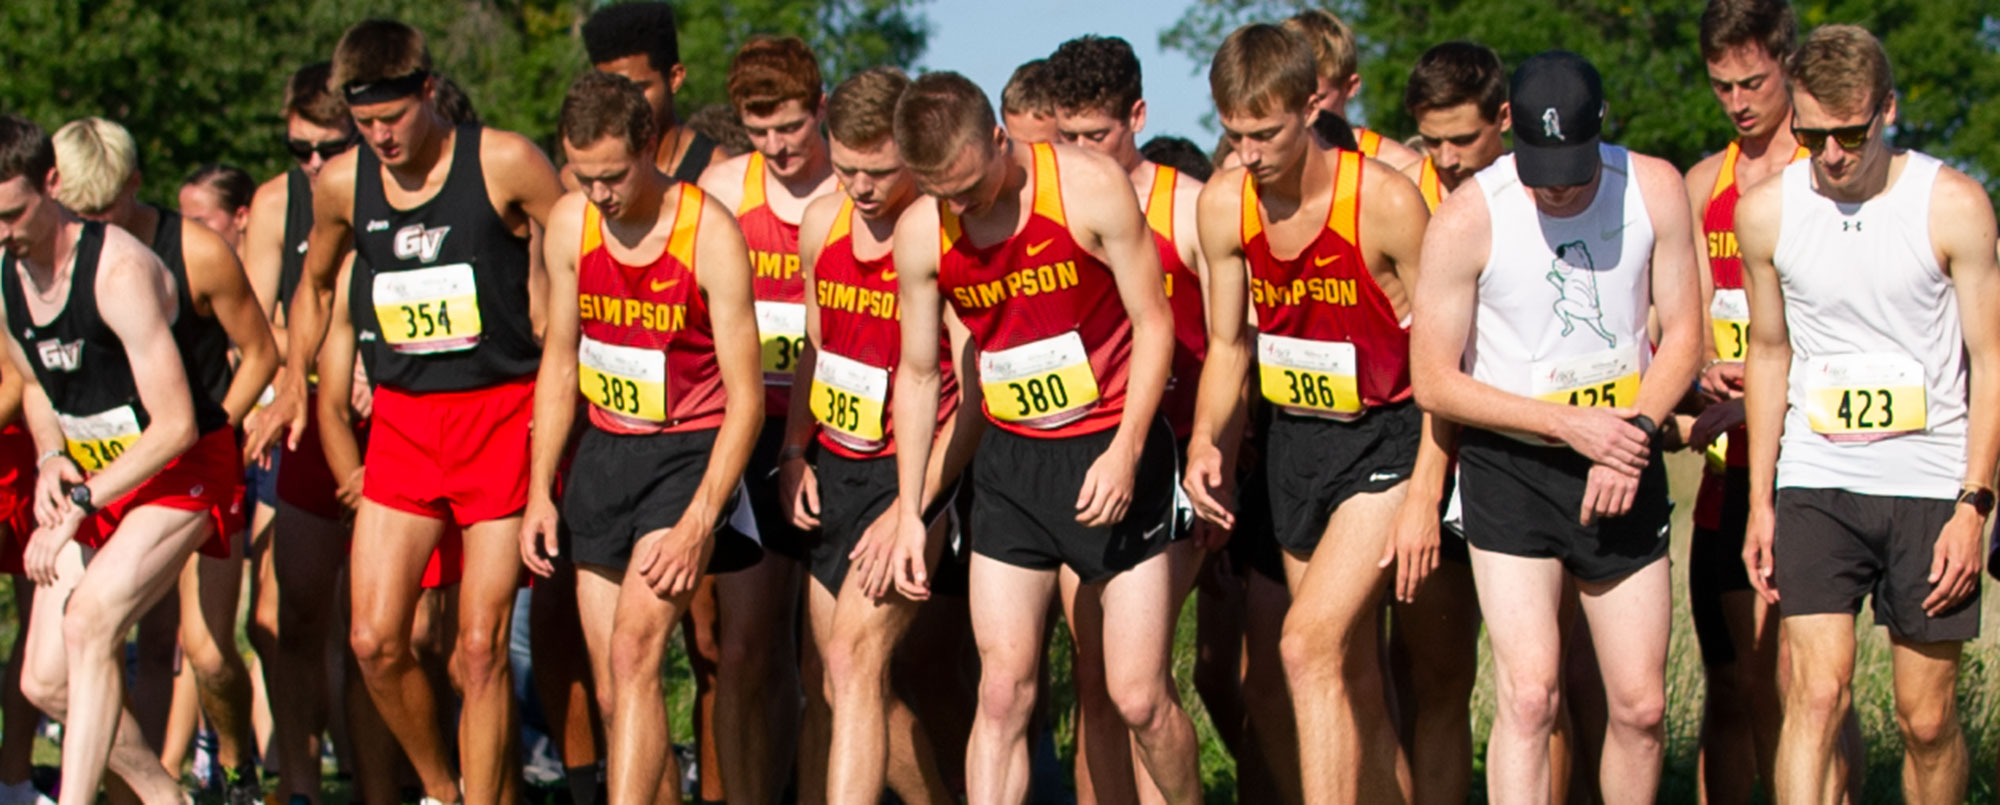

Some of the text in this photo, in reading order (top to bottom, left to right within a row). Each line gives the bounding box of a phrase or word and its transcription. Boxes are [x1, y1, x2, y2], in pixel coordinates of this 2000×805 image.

[394, 223, 451, 263] GV
[954, 261, 1079, 308] SIMPSON
[401, 301, 451, 338] 354
[579, 293, 687, 332] SIMPSON
[598, 373, 640, 414] 383
[826, 387, 860, 431] 385
[1008, 374, 1068, 416] 380
[1284, 370, 1335, 408] 386
[1838, 389, 1893, 428] 423
